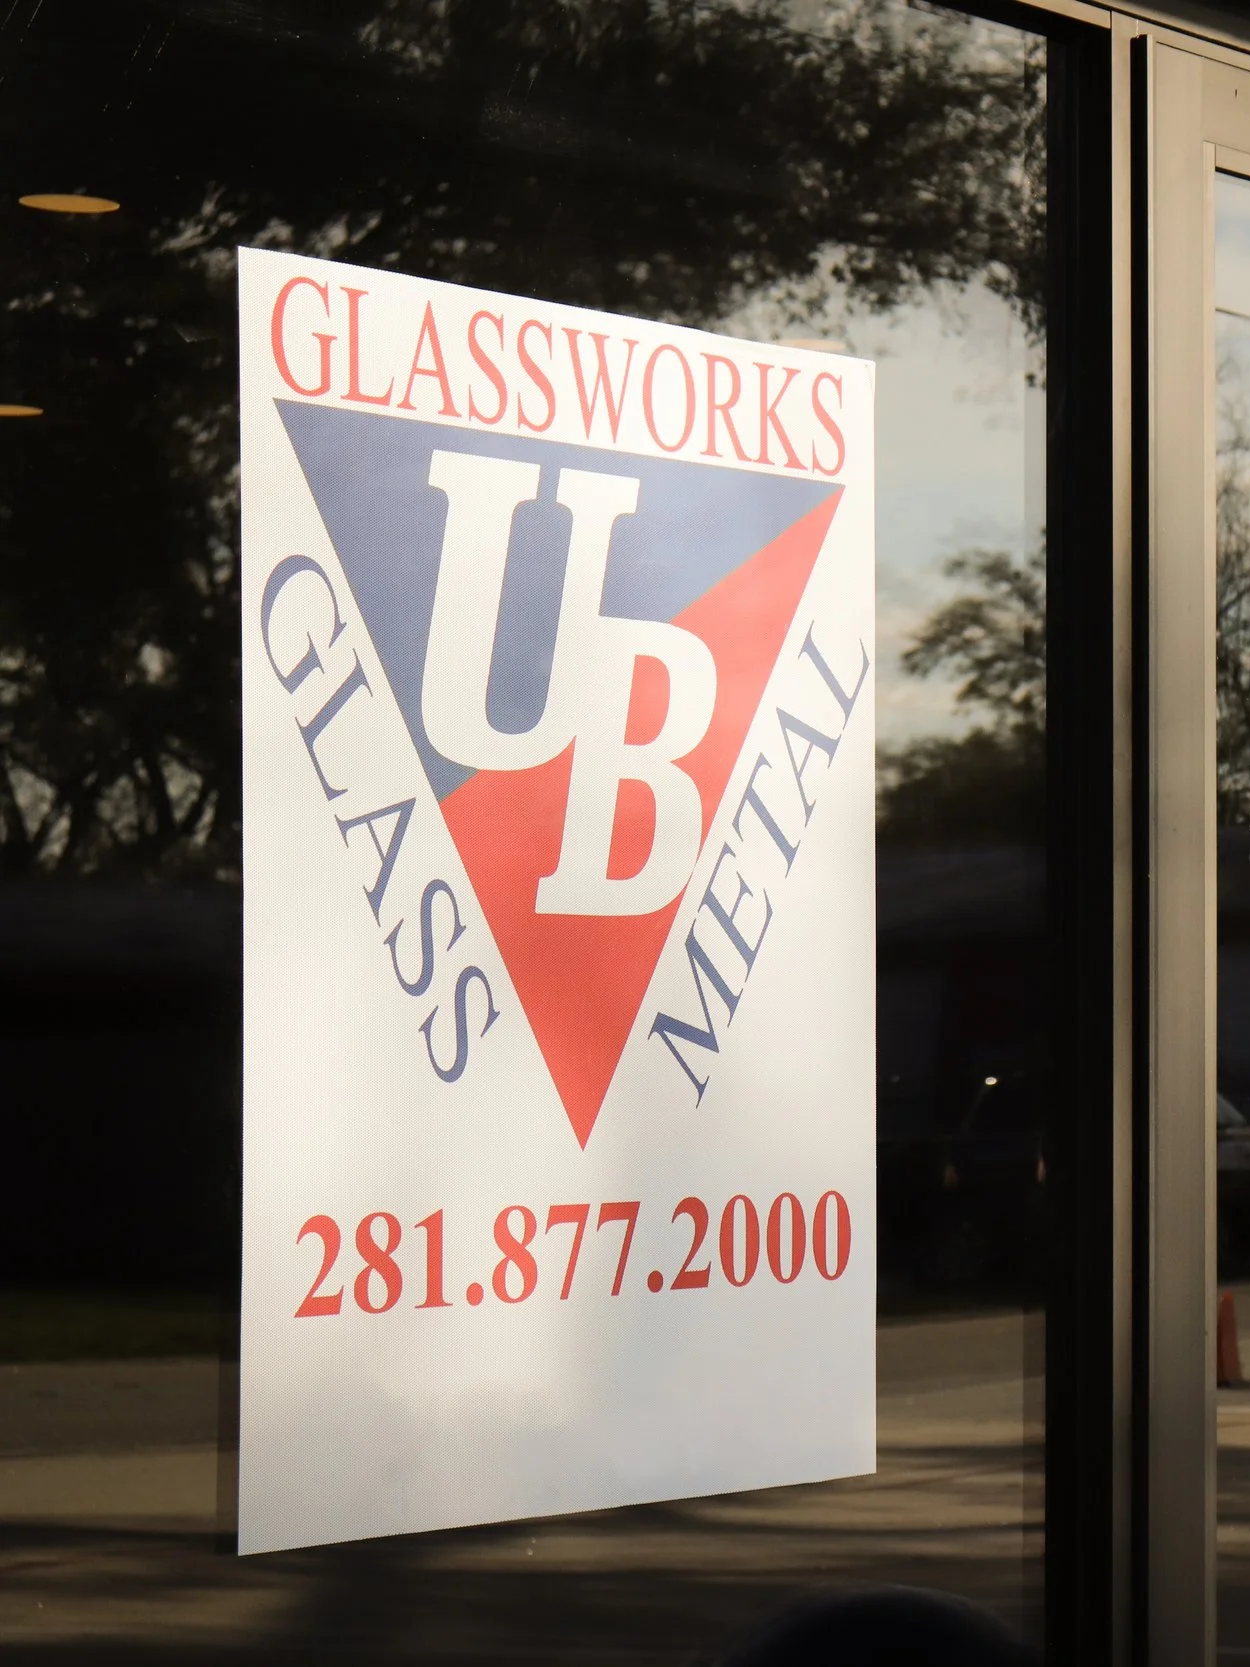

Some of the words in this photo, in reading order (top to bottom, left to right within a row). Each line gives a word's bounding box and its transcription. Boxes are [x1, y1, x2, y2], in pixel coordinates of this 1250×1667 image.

[270, 276, 847, 477] GLASSWORKS
[260, 553, 501, 1084] GLASS
[420, 449, 718, 917] UB
[647, 619, 870, 1109] METAL
[293, 1189, 853, 1319] 281.877.2000
